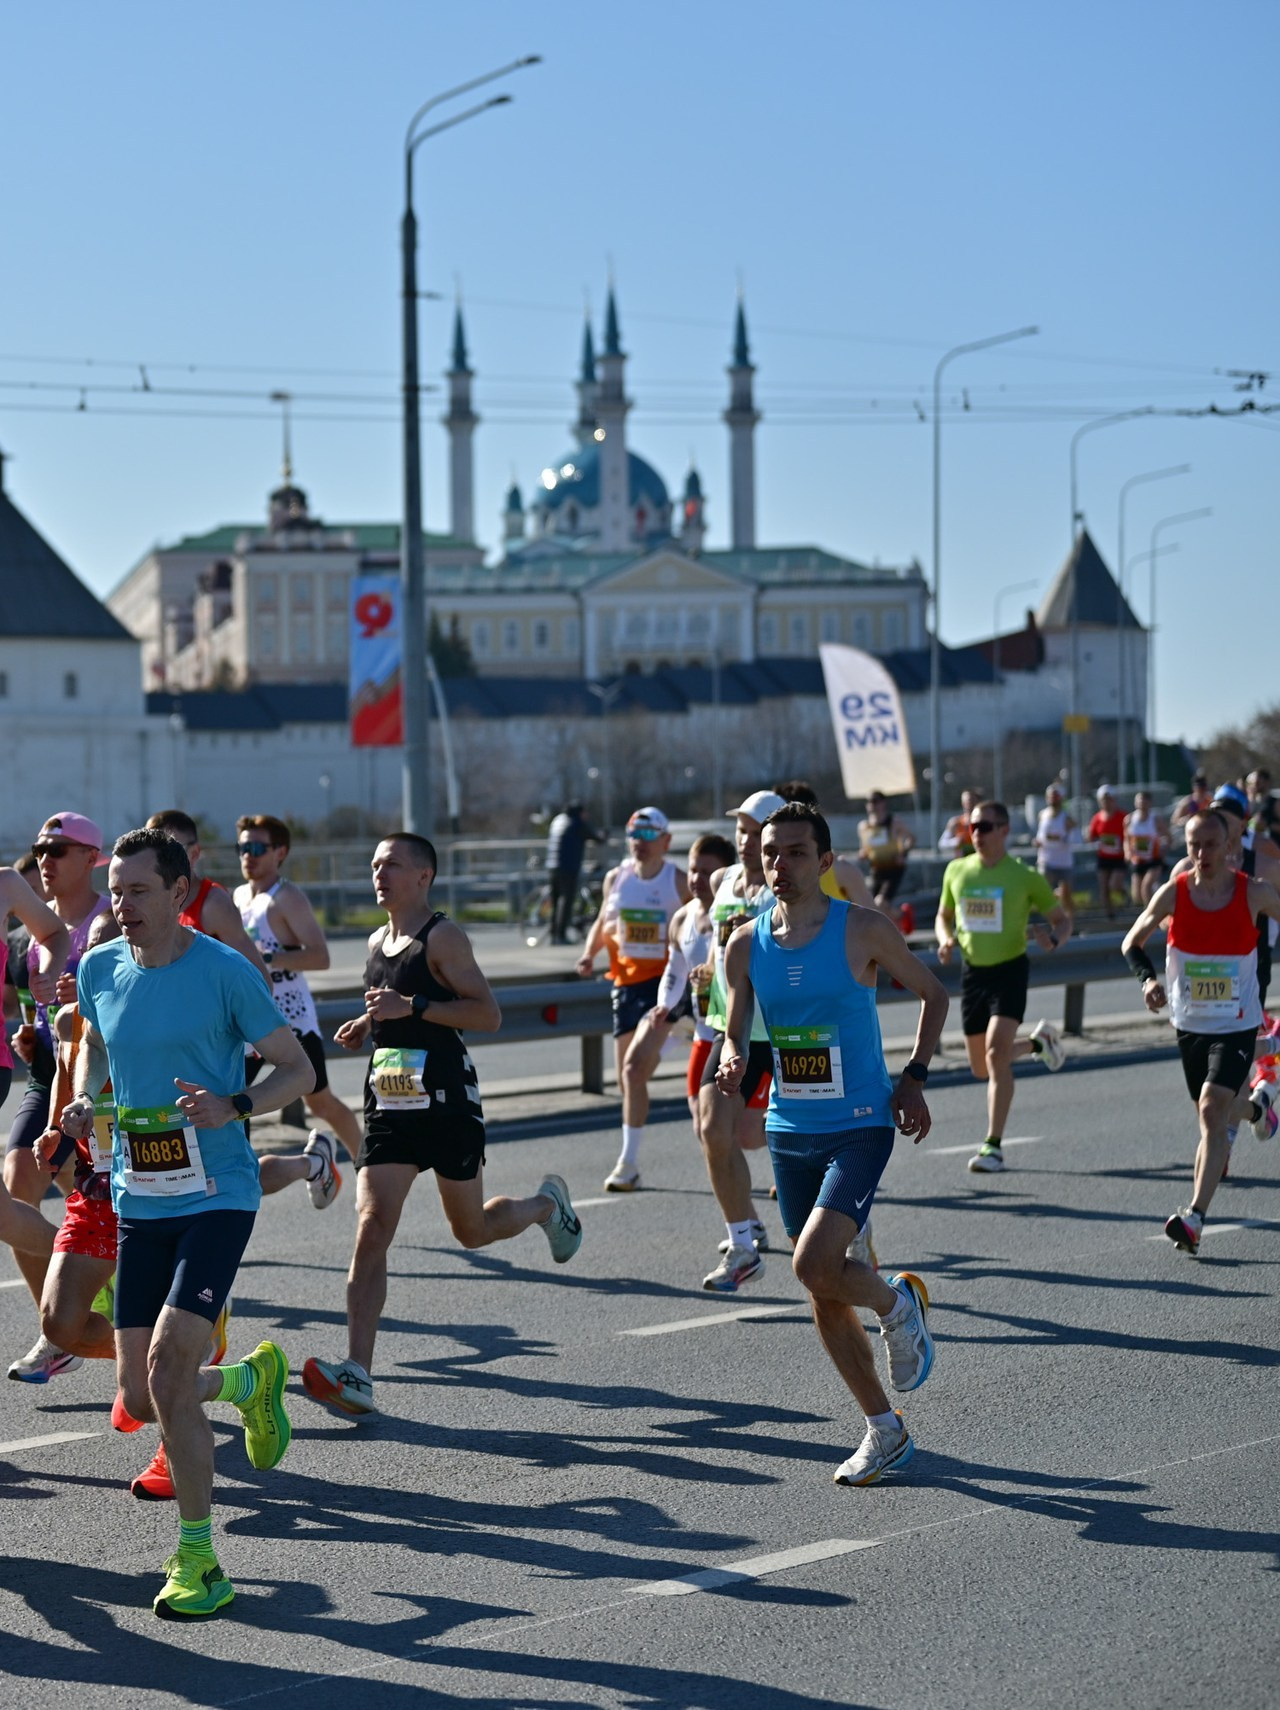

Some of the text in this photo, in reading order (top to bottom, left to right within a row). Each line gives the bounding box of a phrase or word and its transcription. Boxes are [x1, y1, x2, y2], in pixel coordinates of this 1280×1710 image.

[354, 592, 393, 638] 9
[1196, 981, 1226, 996] 7119
[783, 1055, 827, 1076] 16929
[380, 1074, 413, 1091] 21193
[132, 1137, 185, 1164] 16883
